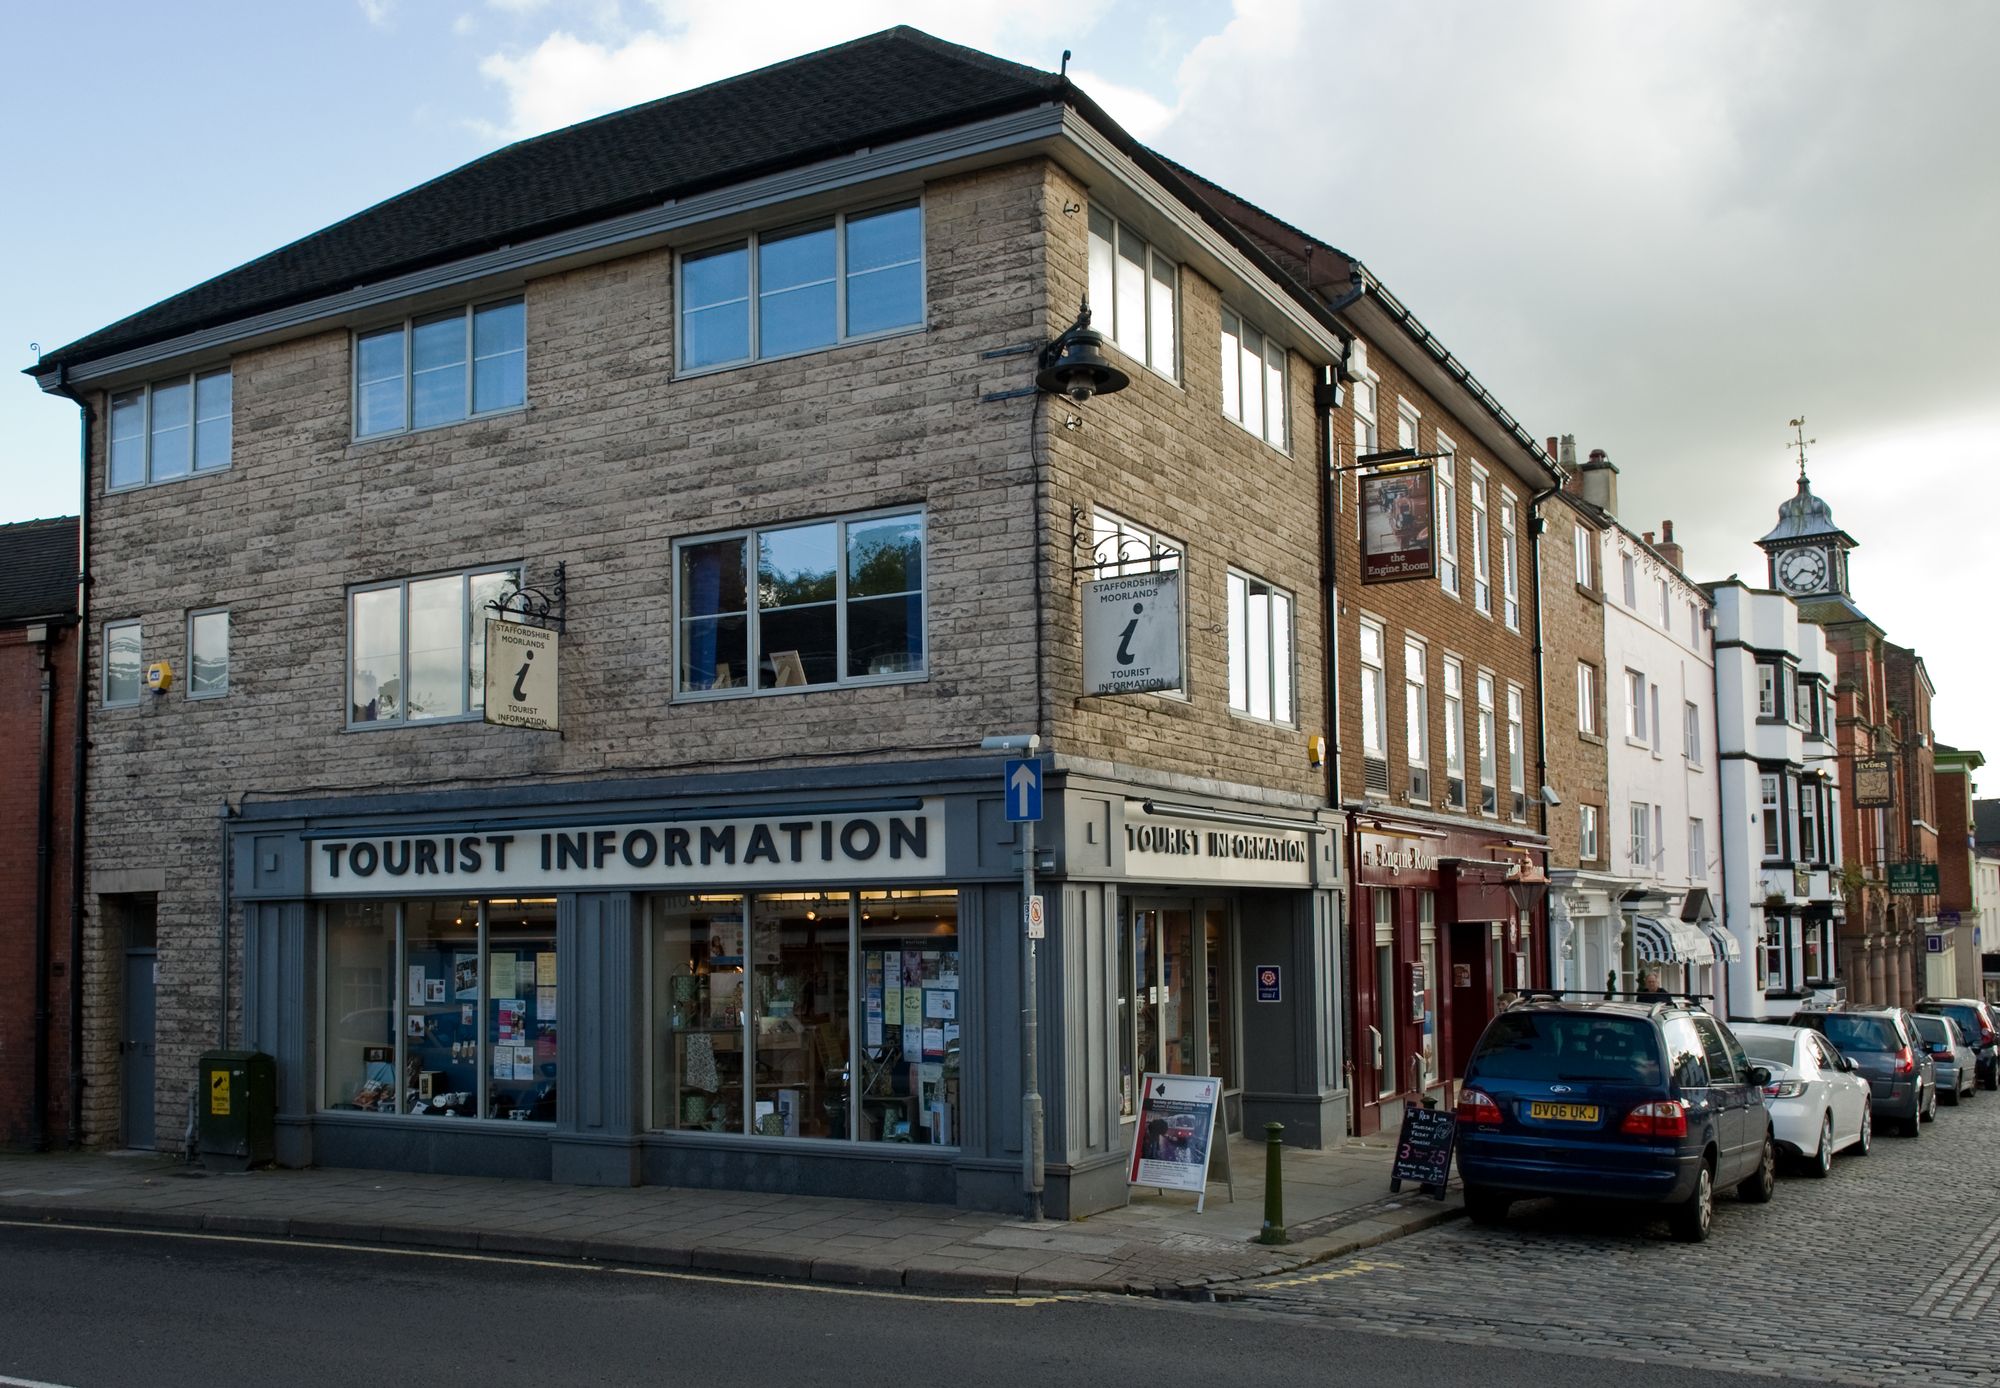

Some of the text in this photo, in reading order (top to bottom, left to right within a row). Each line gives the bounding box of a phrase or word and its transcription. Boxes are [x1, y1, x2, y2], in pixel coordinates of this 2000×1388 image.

[1390, 553, 1406, 563] the
[1367, 561, 1429, 577] Engine Room
[1100, 588, 1158, 603] MOORLANDS
[495, 624, 550, 641] STAFFORDSHIRE
[501, 635, 545, 649] MOORLANDS
[1110, 667, 1151, 679] TOURIST
[1098, 678, 1164, 692] INFORMATION
[508, 704, 538, 715] TOURIST
[498, 713, 548, 726] INFORMATION
[321, 815, 928, 878] TOURIST INFORMATION
[1125, 823, 1305, 863] TOURIST INFORMATION
[1379, 844, 1413, 877] Engine
[1412, 847, 1439, 871] Room
[1533, 1103, 1597, 1120] DV06 UKJ
